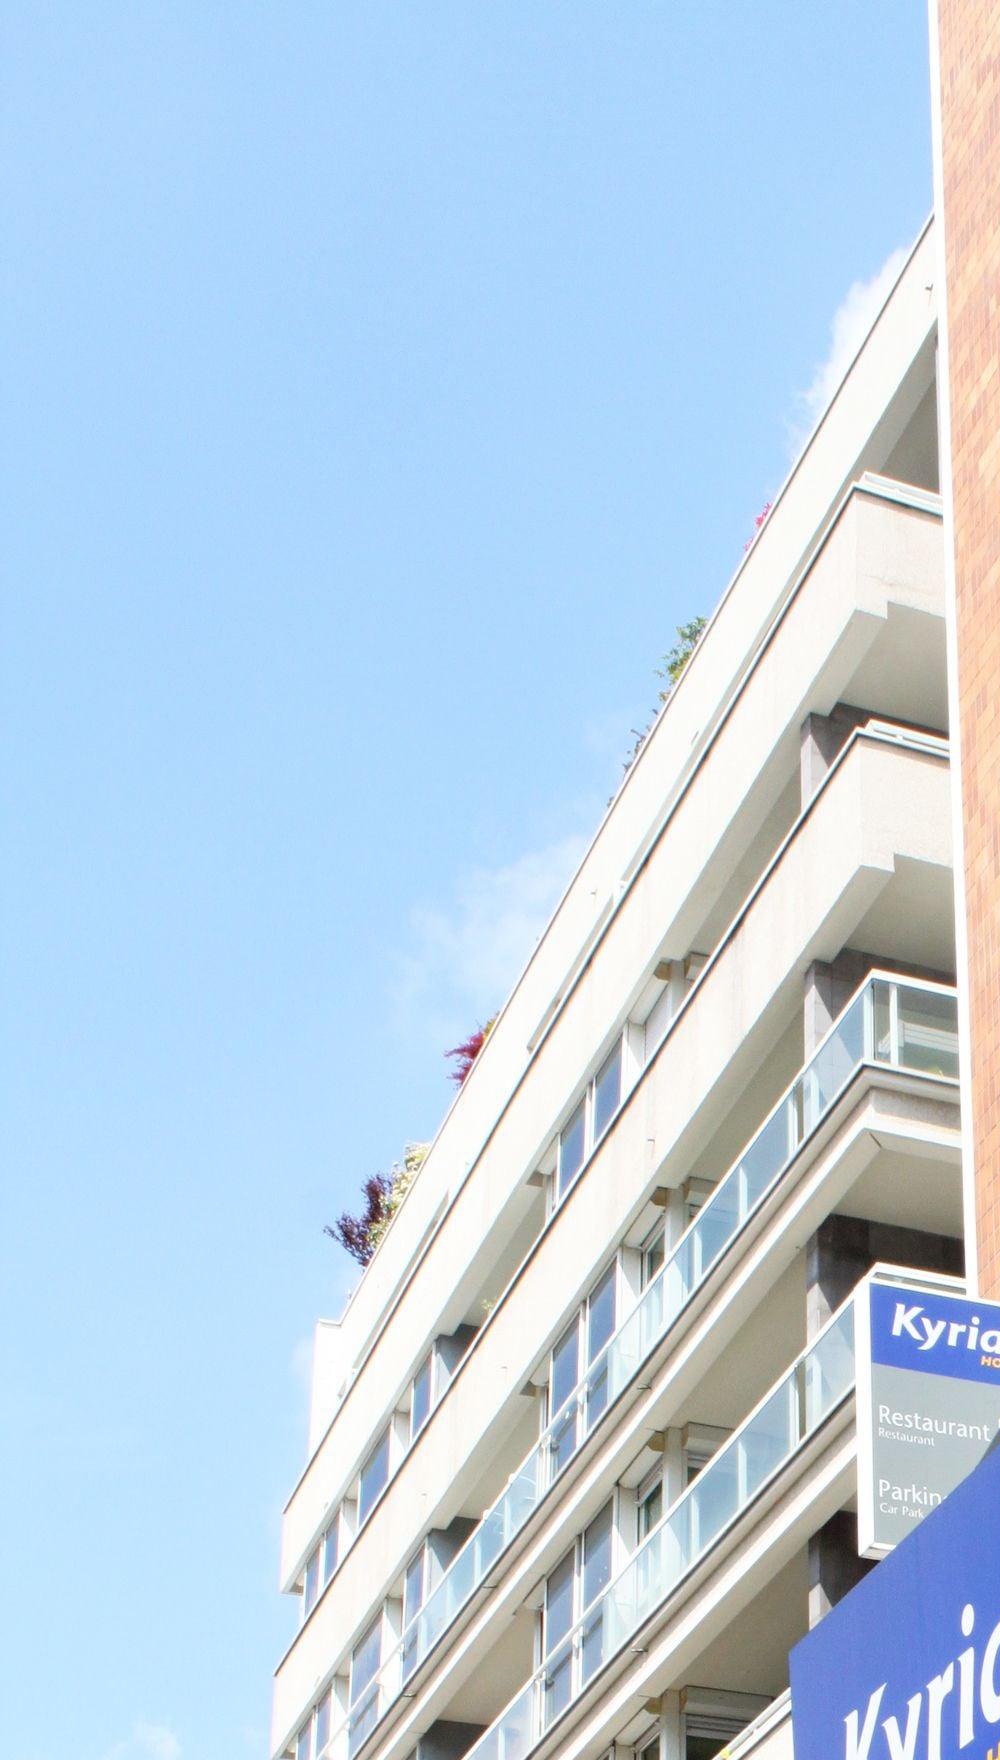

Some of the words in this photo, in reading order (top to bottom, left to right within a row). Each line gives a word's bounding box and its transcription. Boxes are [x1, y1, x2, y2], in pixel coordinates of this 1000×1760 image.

[879, 1405, 991, 1442] Restaurant
[878, 1427, 935, 1446] Restaurant
[879, 1479, 947, 1506] Parkin
[879, 1502, 898, 1514] Car
[902, 1505, 925, 1519] Park
